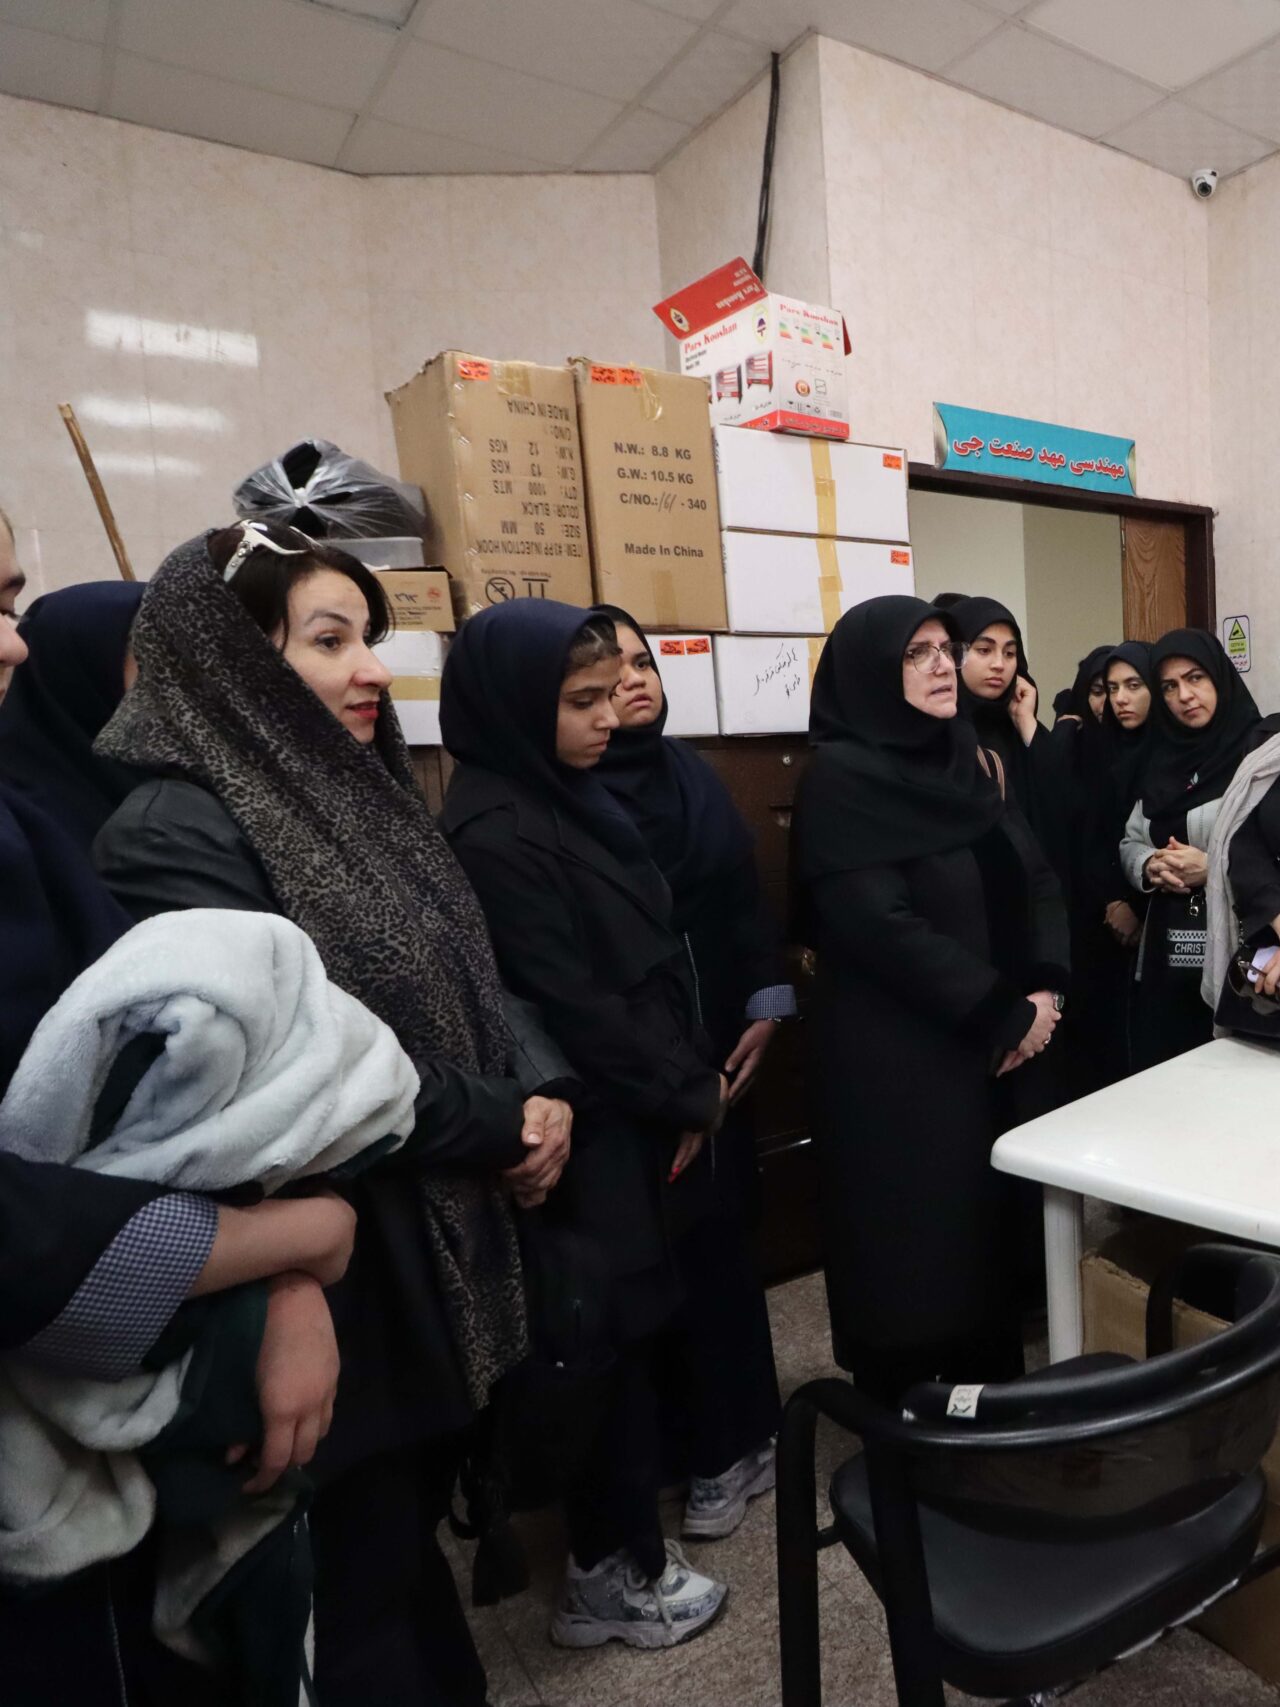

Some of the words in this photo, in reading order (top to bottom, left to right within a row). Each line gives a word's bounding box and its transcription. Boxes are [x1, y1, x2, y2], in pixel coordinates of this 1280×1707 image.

[780, 303, 801, 315] Pars
[803, 310, 838, 326] Kooshan
[684, 340, 702, 354] Pars
[703, 322, 738, 345] Kooshan
[506, 399, 537, 416] CHINA
[537, 403, 547, 417] IN
[547, 404, 570, 421] MADE
[489, 438, 508, 453] KGS
[528, 441, 539, 456] 12
[614, 442, 645, 455] N.W.:
[651, 445, 669, 457] 8.8
[675, 448, 691, 460] KG
[953, 435, 984, 458] جی
[989, 439, 1034, 460] صنعت
[1038, 448, 1066, 469] مهد
[491, 459, 511, 474] KGS
[530, 463, 542, 477] 13
[1070, 457, 1126, 480] مهندسی
[617, 467, 647, 480] G.W.:
[651, 470, 675, 482] 10.5
[677, 473, 694, 484] KG
[492, 480, 512, 494] MTS
[521, 501, 551, 516] BLACK
[687, 498, 707, 510] 340
[501, 520, 518, 534] MM
[535, 522, 545, 536] 50
[477, 539, 500, 554] HOOK
[501, 540, 542, 555] INJECTION
[624, 543, 656, 555] Made
[659, 545, 670, 556] In
[673, 546, 704, 558] China
[1174, 943, 1206, 954] CHRIST
